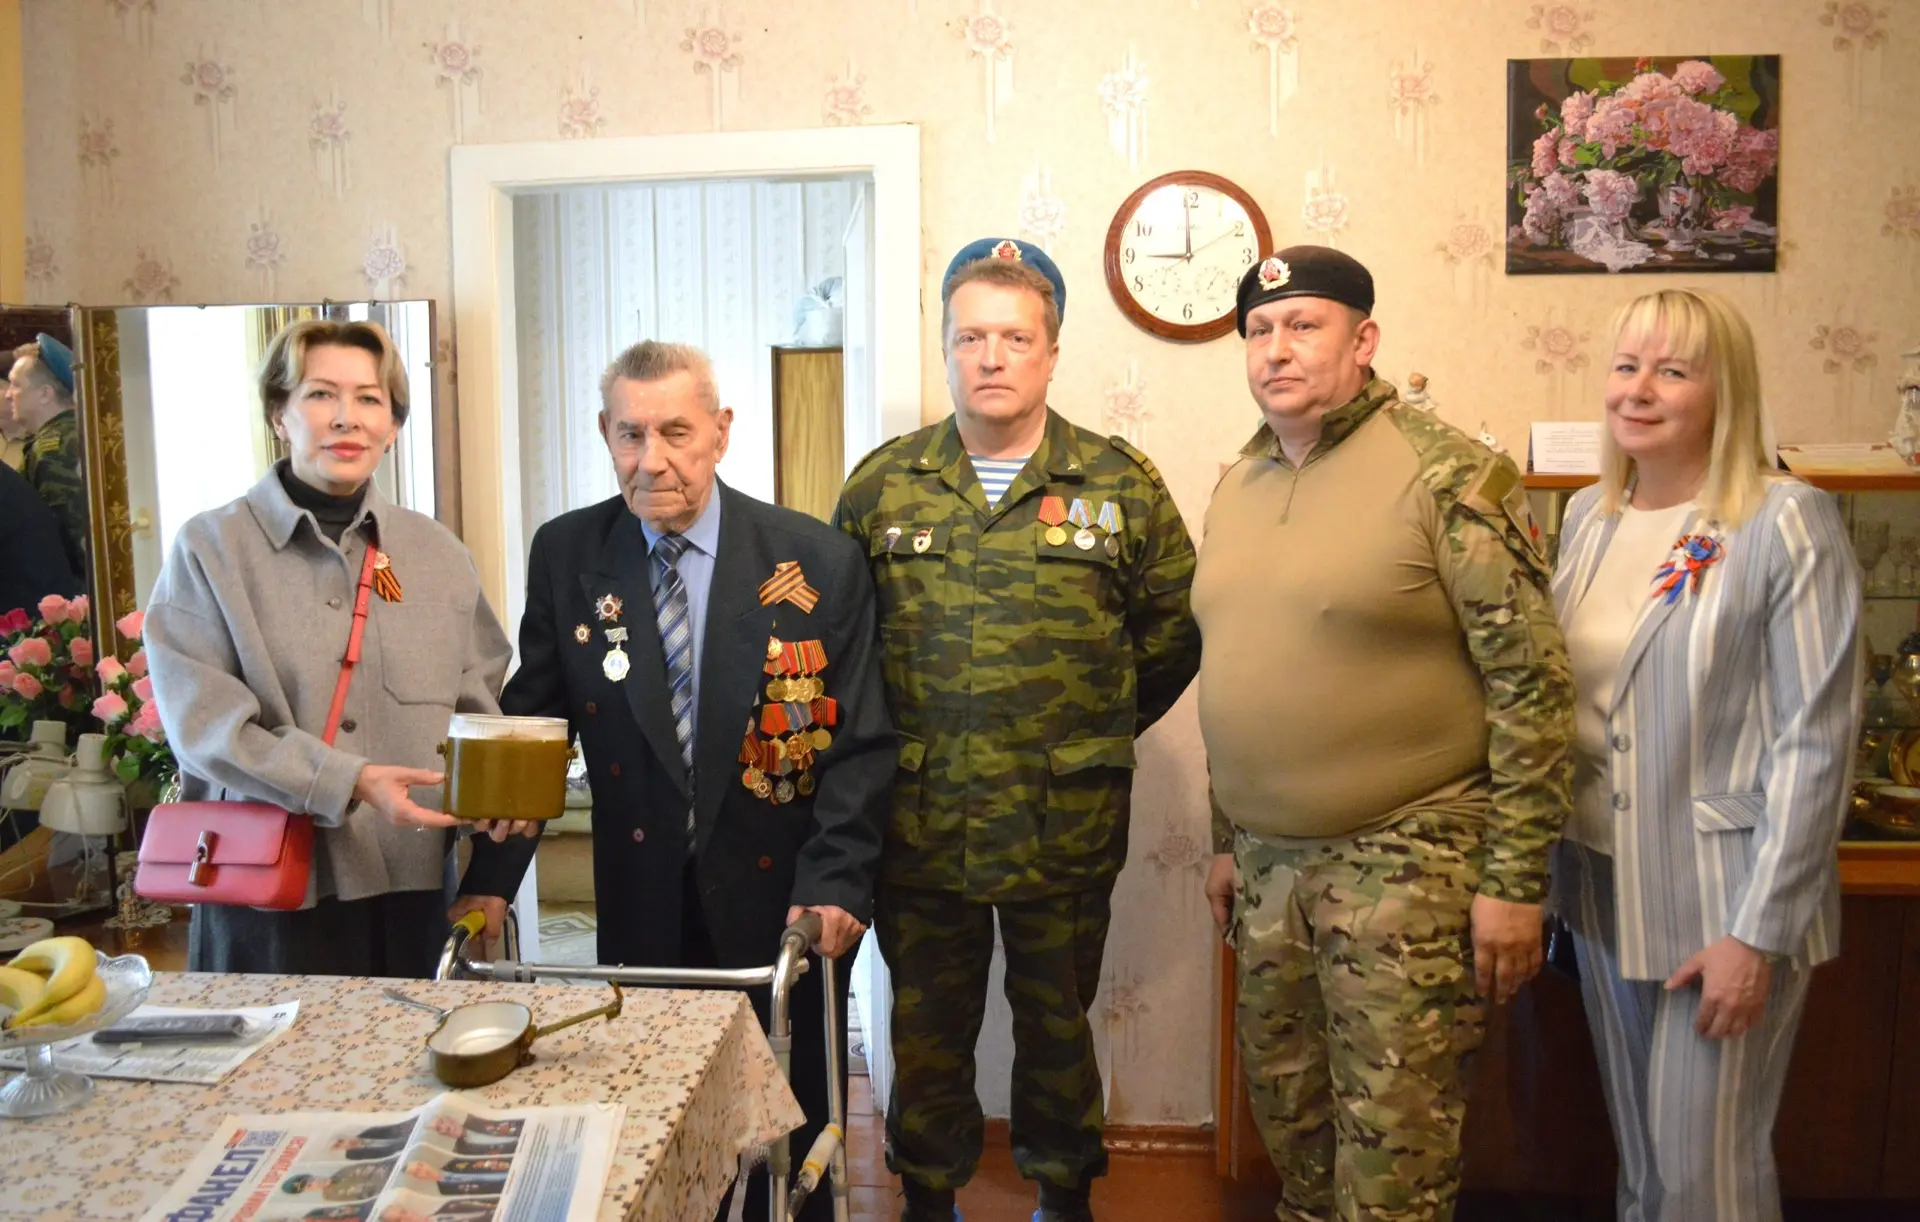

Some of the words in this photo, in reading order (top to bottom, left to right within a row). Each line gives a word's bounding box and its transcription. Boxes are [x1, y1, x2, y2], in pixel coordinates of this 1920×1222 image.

[1135, 220, 1153, 237] 10
[1234, 221, 1245, 237] 2
[1125, 248, 1136, 264] 9
[1242, 248, 1252, 264] 3
[1133, 275, 1144, 292] 8
[1182, 303, 1193, 320] 6
